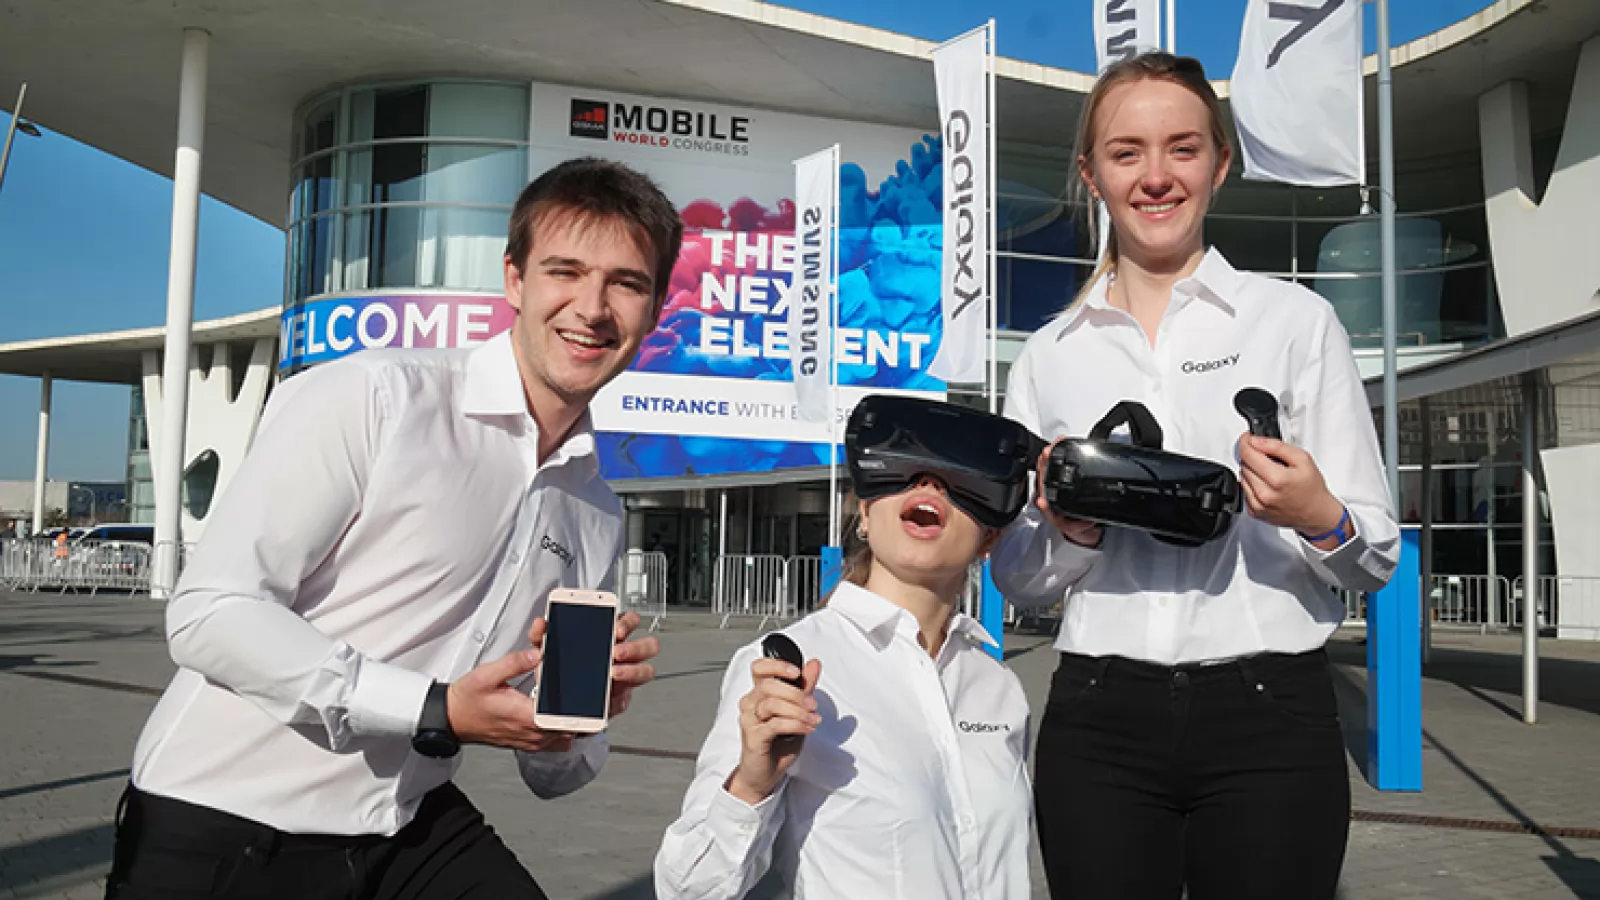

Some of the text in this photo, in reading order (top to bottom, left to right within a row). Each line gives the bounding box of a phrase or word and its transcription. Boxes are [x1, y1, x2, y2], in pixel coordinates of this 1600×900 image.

[613, 103, 749, 142] MOBILE
[613, 131, 749, 156] WORLD CONGRESS
[702, 228, 798, 271] THE
[701, 271, 790, 316] NEX
[700, 316, 931, 370] ELEENT
[1181, 353, 1240, 374] Galaxy
[622, 394, 730, 416] ENTRANCE
[735, 401, 786, 420] WITH
